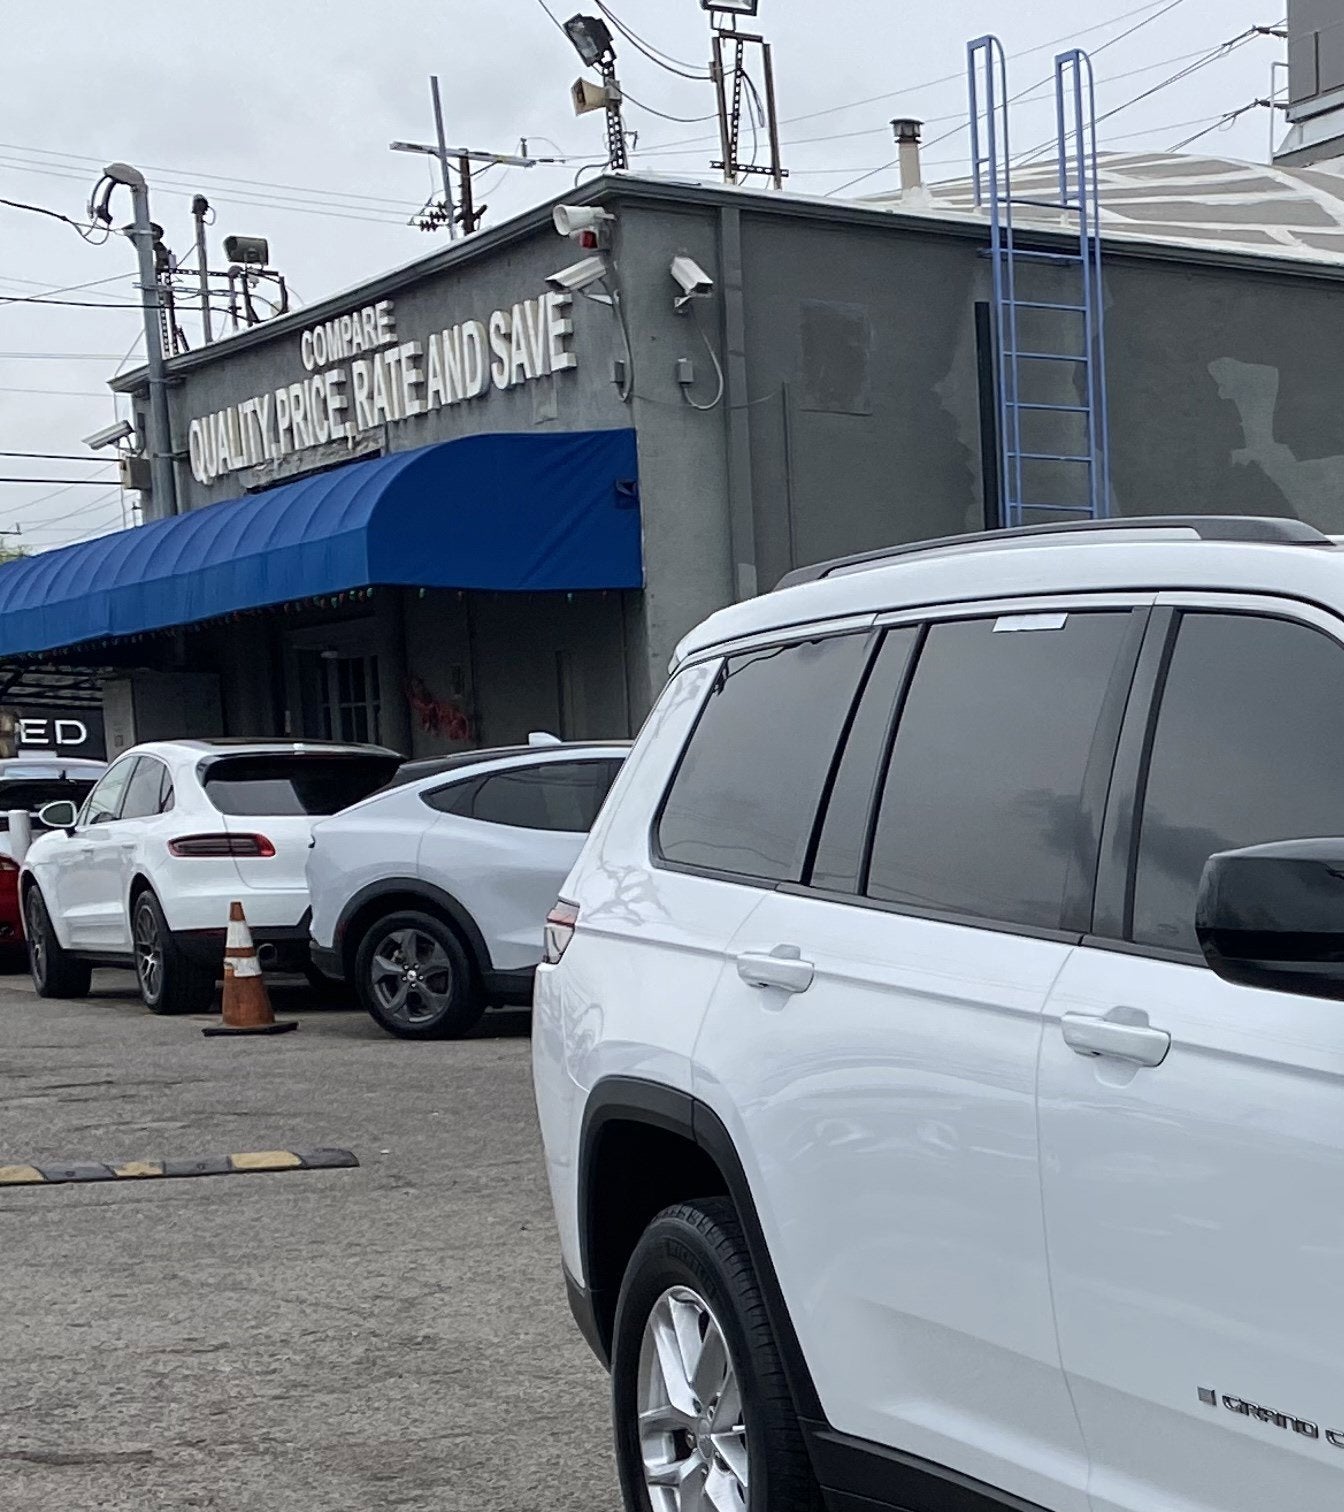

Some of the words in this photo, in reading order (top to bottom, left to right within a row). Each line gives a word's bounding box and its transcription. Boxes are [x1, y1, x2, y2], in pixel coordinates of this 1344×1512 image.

[301, 300, 397, 371] COMPARE
[352, 341, 427, 431] RATE
[427, 320, 490, 411] AND
[489, 291, 577, 390] SAVE
[1221, 1393, 1319, 1439] GRAND
